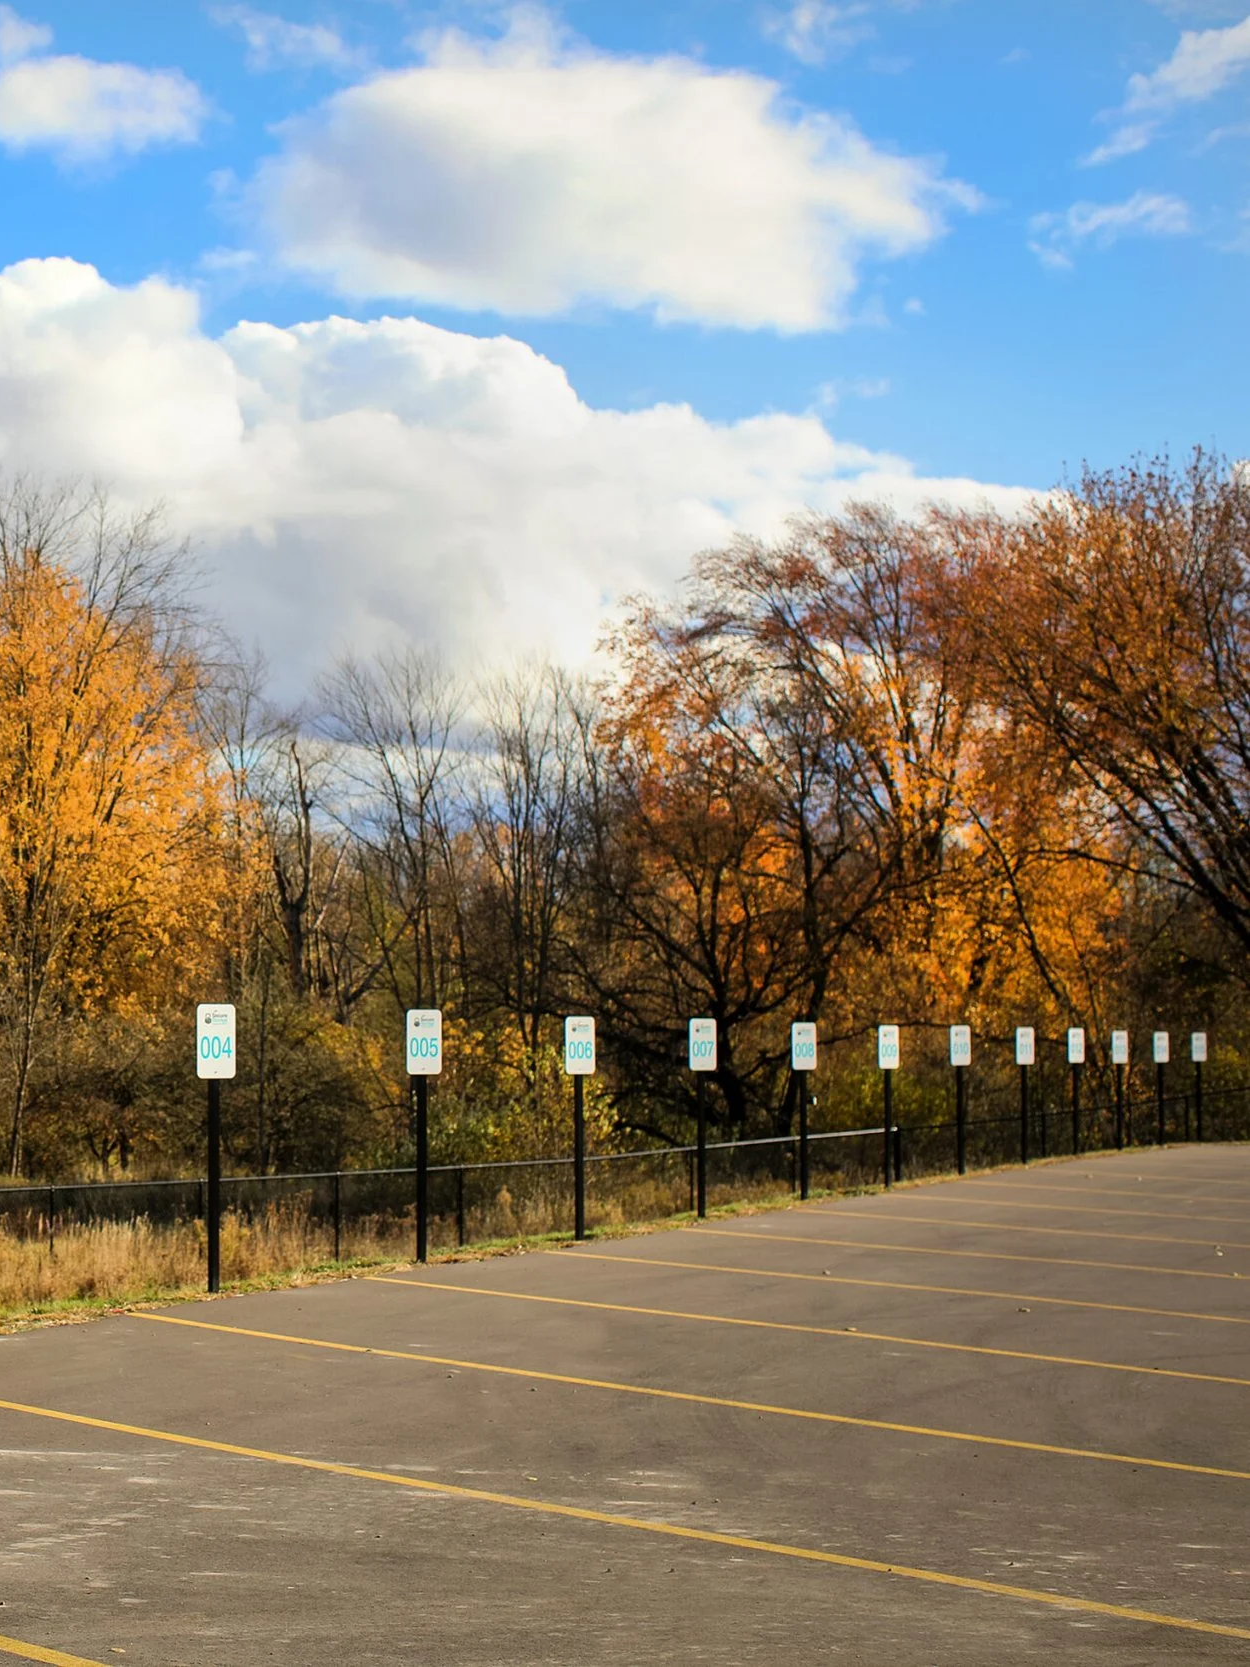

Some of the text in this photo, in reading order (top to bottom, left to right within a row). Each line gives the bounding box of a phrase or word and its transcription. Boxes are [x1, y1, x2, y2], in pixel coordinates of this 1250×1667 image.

[200, 1036, 232, 1059] 004
[410, 1037, 439, 1058] 005
[568, 1041, 593, 1059] 006
[692, 1041, 714, 1057] 007
[795, 1043, 815, 1058] 008
